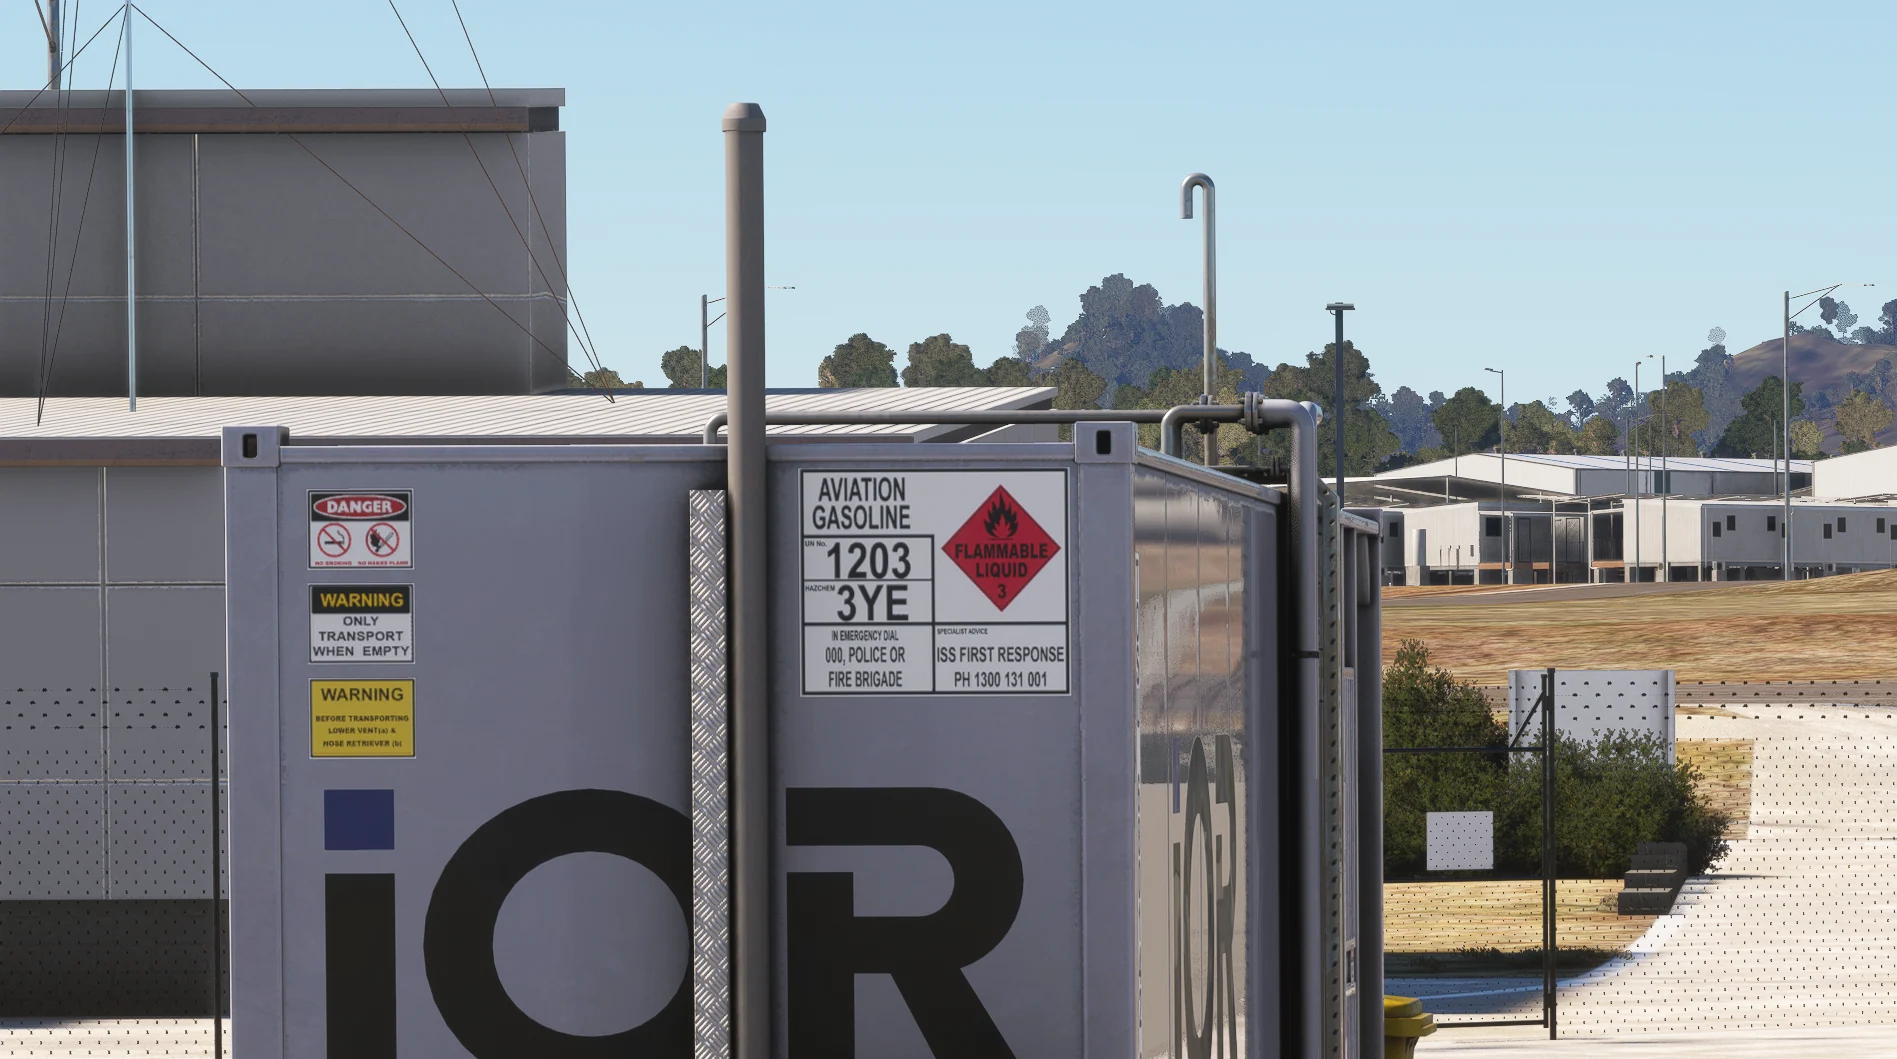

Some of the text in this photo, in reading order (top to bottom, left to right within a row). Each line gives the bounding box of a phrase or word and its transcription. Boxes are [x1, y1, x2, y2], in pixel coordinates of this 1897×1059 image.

[818, 477, 905, 501] AVIATION
[326, 500, 393, 514] DANGER
[813, 505, 910, 529] GASOLINE
[955, 543, 1048, 559] FLAMMABLE
[827, 542, 911, 579] 1203
[976, 562, 1027, 578] LIQUID
[997, 584, 1006, 599] 3
[320, 593, 404, 608] WARNING
[837, 584, 909, 622] 3YE
[343, 616, 379, 626] ONLY
[319, 631, 403, 641] TRANSPORT
[832, 630, 899, 641] IN EMERGENCY DIAL
[313, 646, 409, 656] WHEN EMPTY
[825, 647, 905, 665] 000, POLICE OR
[937, 646, 1064, 662] ISS FIRST RESPONSE
[829, 671, 902, 687] FIRE BRIGADE
[954, 672, 1047, 687] PH 1300 131 001
[321, 688, 403, 701] WARNING
